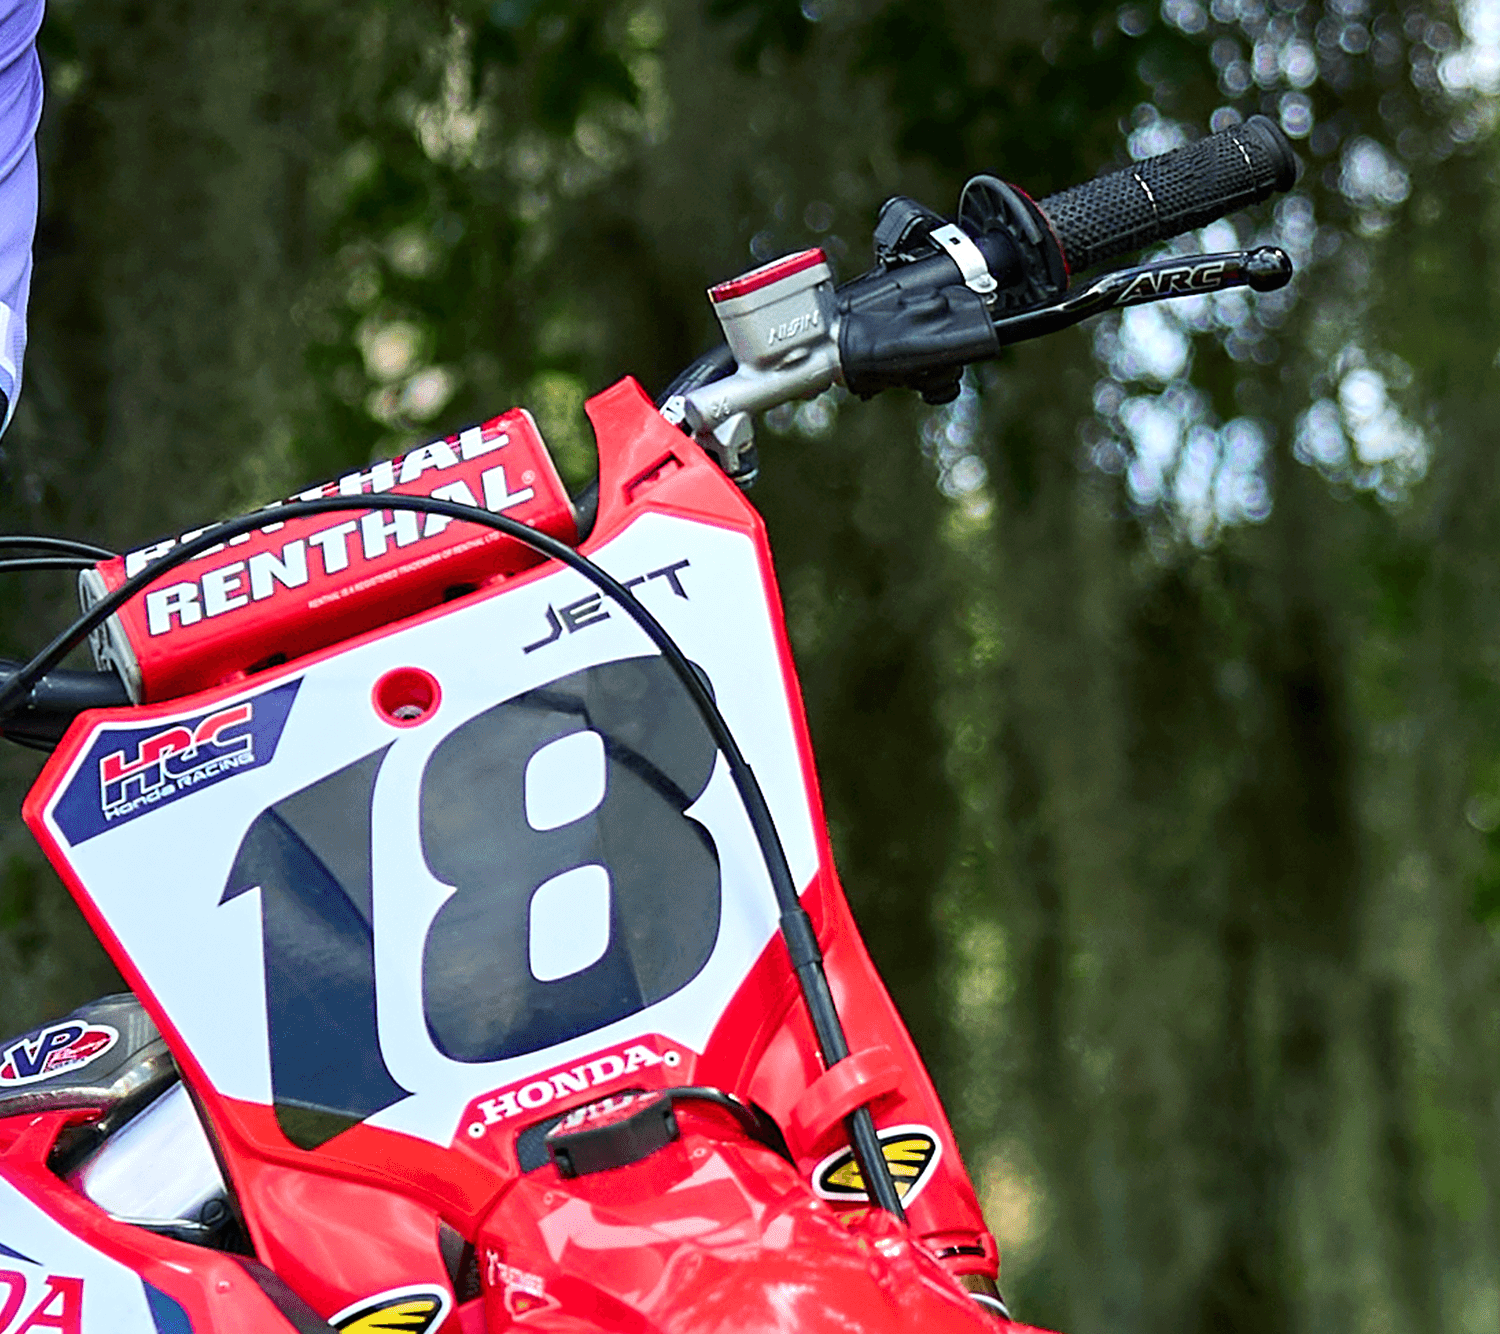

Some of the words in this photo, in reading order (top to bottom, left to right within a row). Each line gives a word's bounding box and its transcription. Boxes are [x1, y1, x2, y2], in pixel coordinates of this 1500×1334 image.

[1113, 261, 1226, 305] ARC
[145, 464, 536, 637] RENTHAL
[99, 701, 254, 812] HRC
[104, 782, 177, 821] Honda
[177, 752, 255, 791] RACING
[217, 653, 723, 1152] 18
[11, 1026, 83, 1078] VP
[477, 1044, 664, 1125] HONDA
